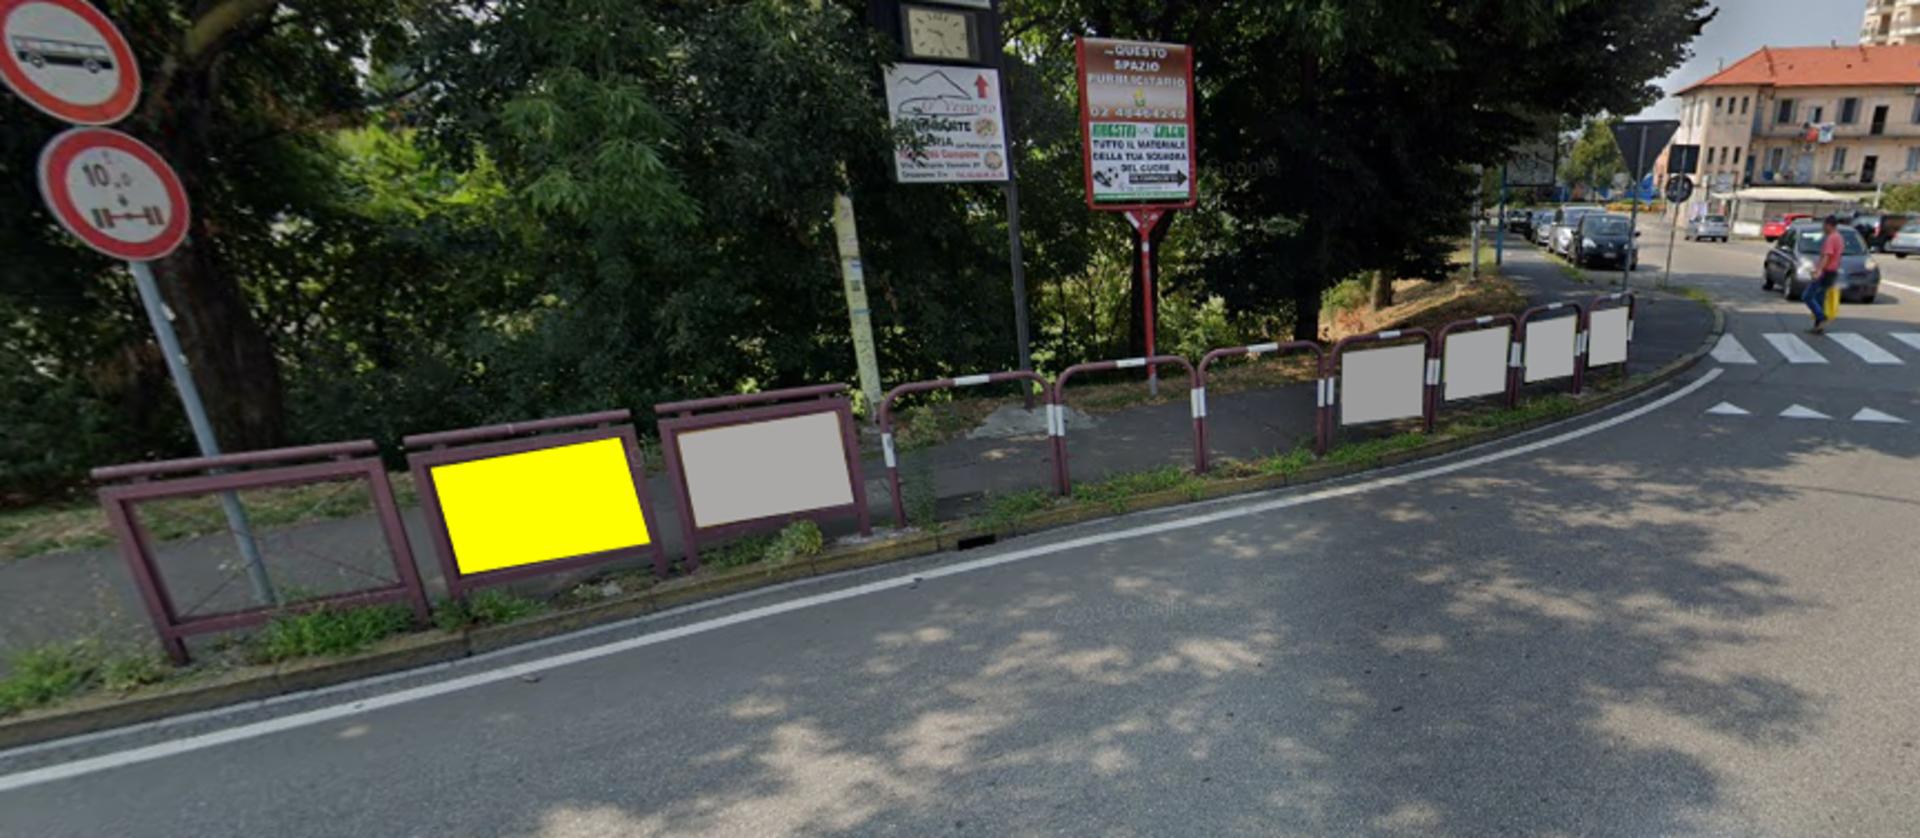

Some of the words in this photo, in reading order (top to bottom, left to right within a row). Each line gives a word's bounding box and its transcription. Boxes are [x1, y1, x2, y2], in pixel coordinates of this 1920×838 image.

[1114, 60, 1160, 72] SPAZIO
[1087, 73, 1185, 88] PUBBLICITARIO
[1092, 140, 1125, 149] TUTTO
[1126, 140, 1136, 149] IL
[1137, 140, 1186, 150] MATERIALE
[1092, 152, 1123, 161] DELLA
[1125, 152, 1144, 161] TUA
[1146, 152, 1187, 161] SQUADRA
[1121, 164, 1138, 173] DEL
[1139, 164, 1170, 172] CUORE
